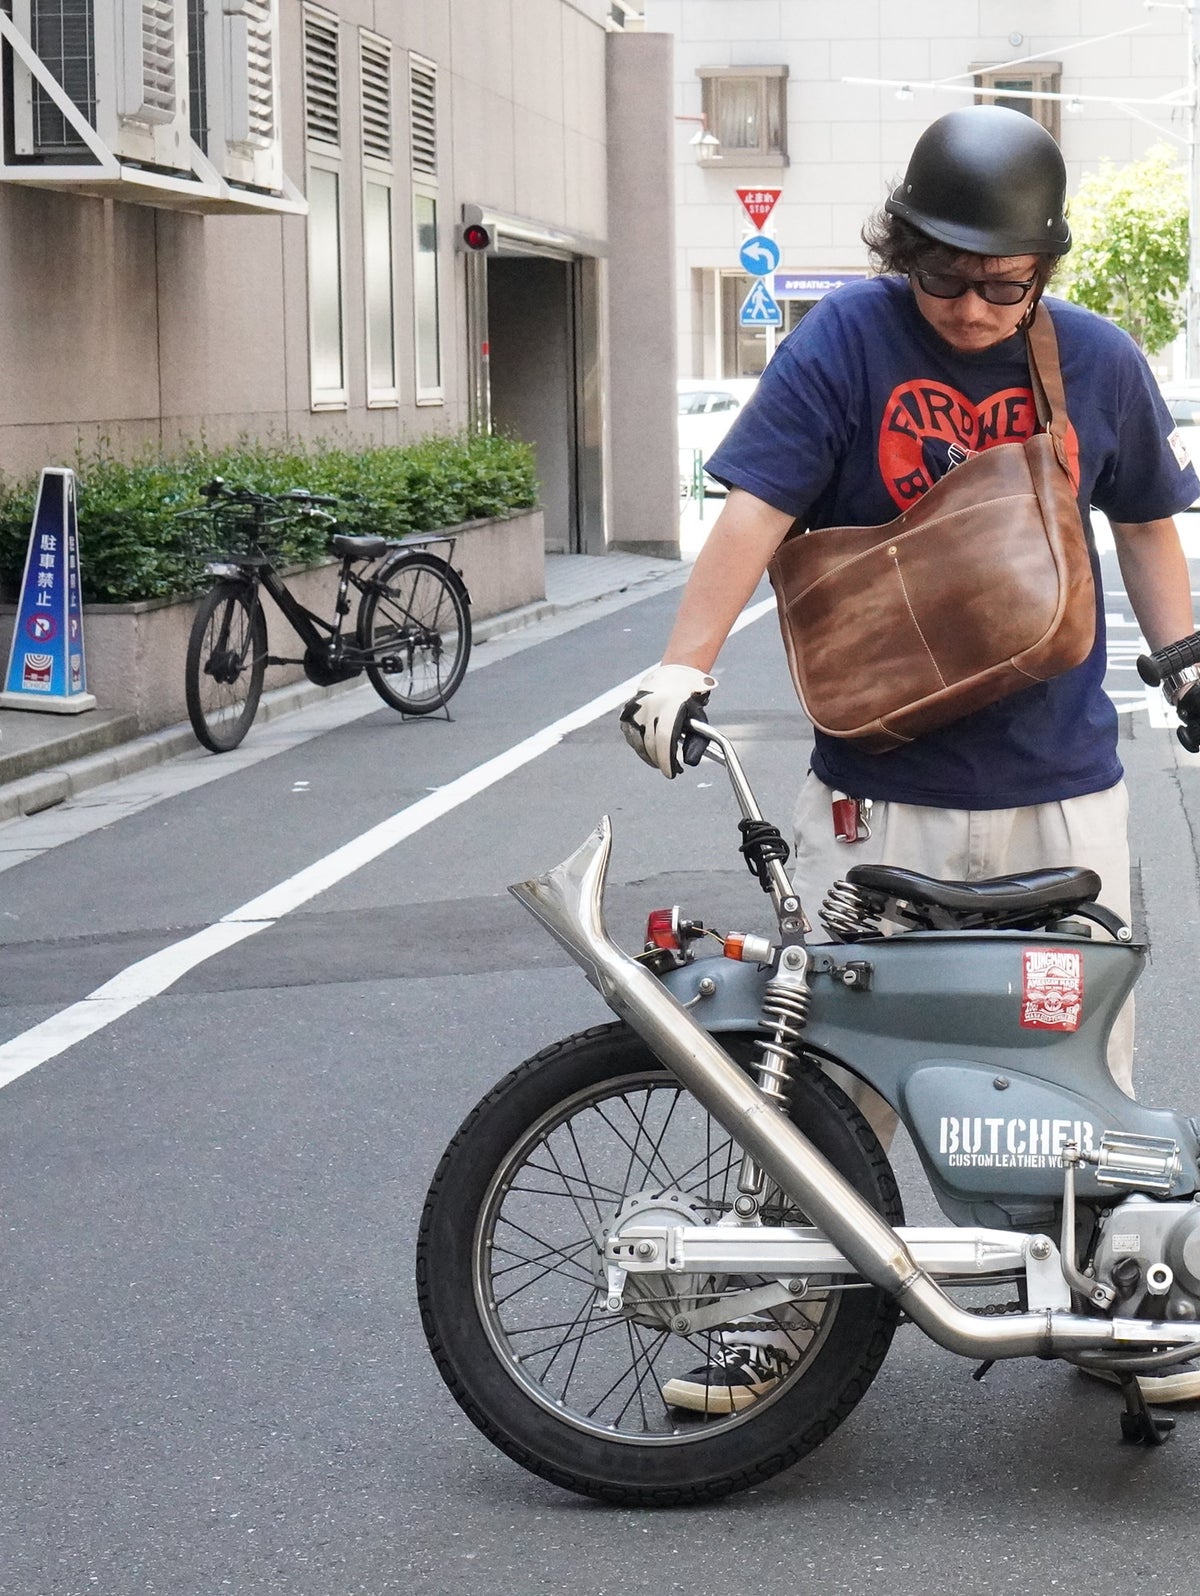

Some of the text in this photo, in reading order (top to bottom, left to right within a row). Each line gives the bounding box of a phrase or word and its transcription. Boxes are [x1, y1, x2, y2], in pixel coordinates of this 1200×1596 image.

[743, 192, 774, 203] 止まれ
[749, 204, 770, 214] STOP
[36, 534, 57, 607] 駐車禁止
[1060, 980, 1080, 991] MADE
[939, 1117, 1094, 1155] BUTCHER
[949, 1154, 1086, 1169] CUSTOM LEATHER WOS
